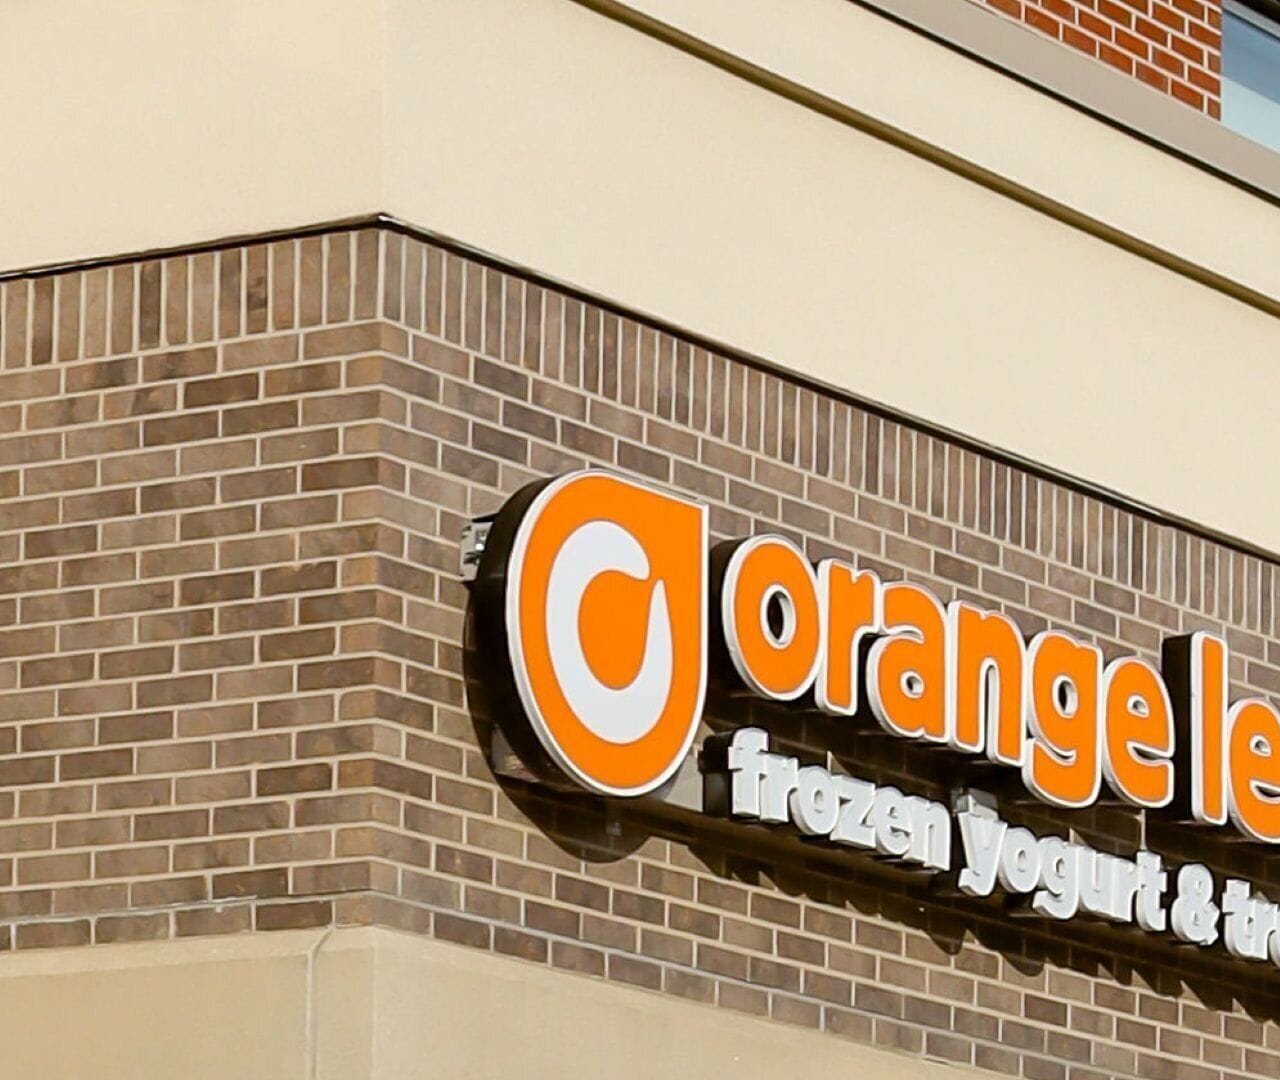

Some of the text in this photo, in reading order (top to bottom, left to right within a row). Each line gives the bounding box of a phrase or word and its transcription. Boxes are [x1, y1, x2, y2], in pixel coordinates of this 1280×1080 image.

[723, 534, 1175, 808] orange
[728, 727, 952, 872] frozen
[957, 800, 1168, 932] yogurt
[1171, 863, 1220, 946] &
